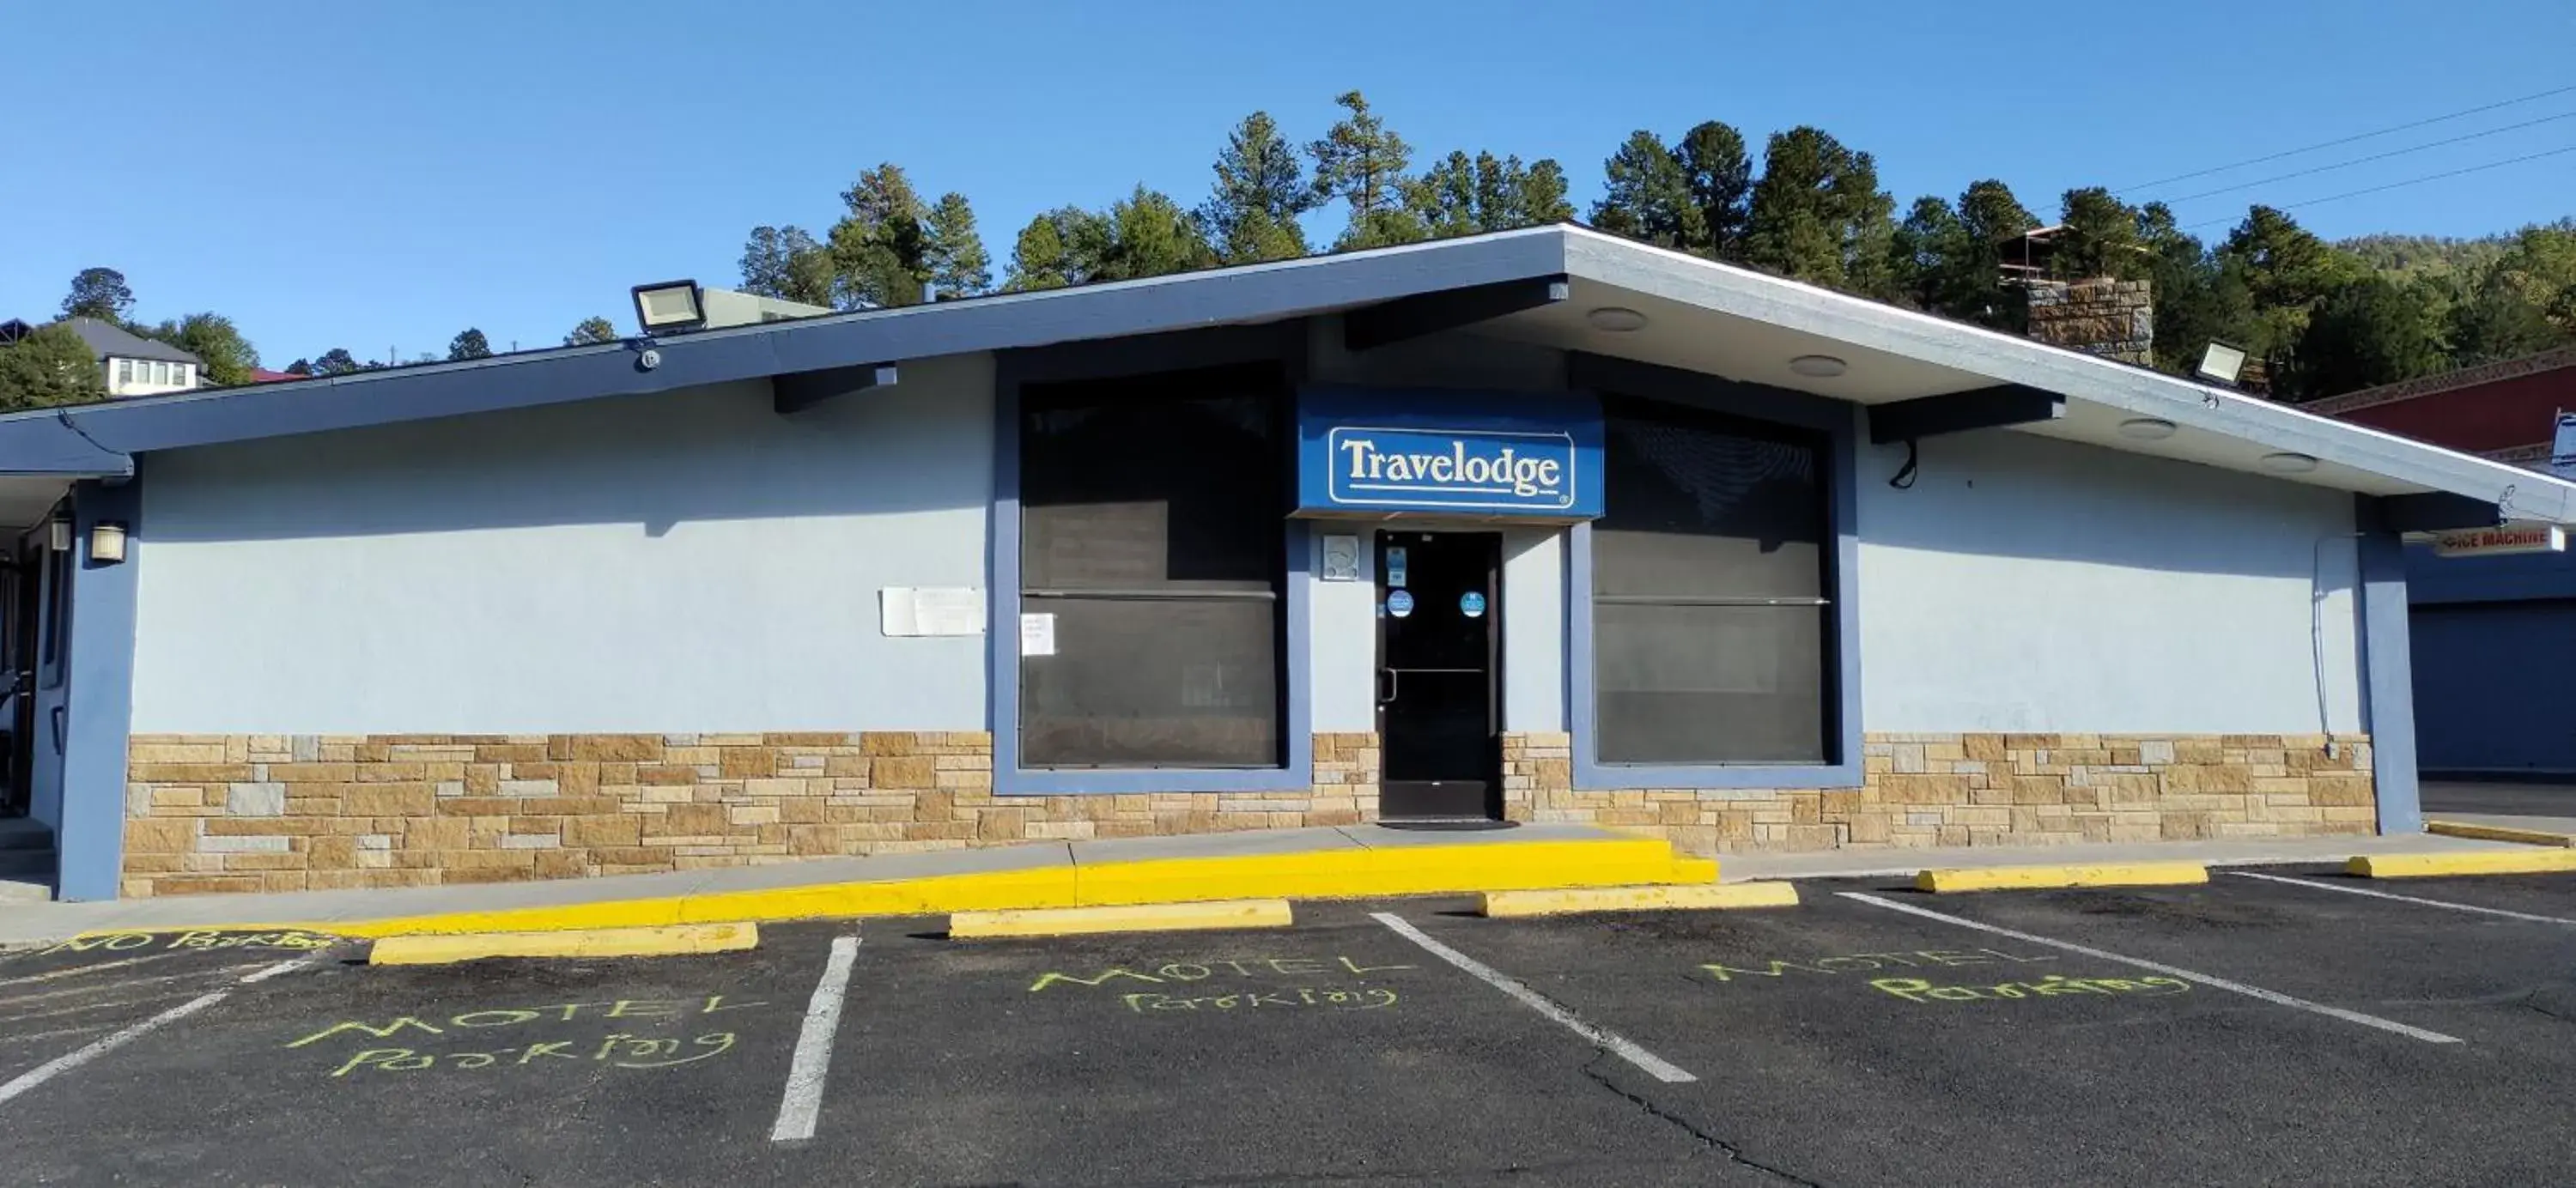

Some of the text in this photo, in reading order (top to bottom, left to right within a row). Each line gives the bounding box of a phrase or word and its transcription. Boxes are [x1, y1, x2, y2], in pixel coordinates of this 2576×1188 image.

[1340, 439, 1561, 497] Travelodge
[2458, 529, 2549, 549] ICE MACHINE
[40, 931, 154, 955] NO
[1030, 955, 1419, 991] MOTEL
[1696, 948, 2059, 981] MOTEL
[283, 996, 769, 1048] MOTEL
